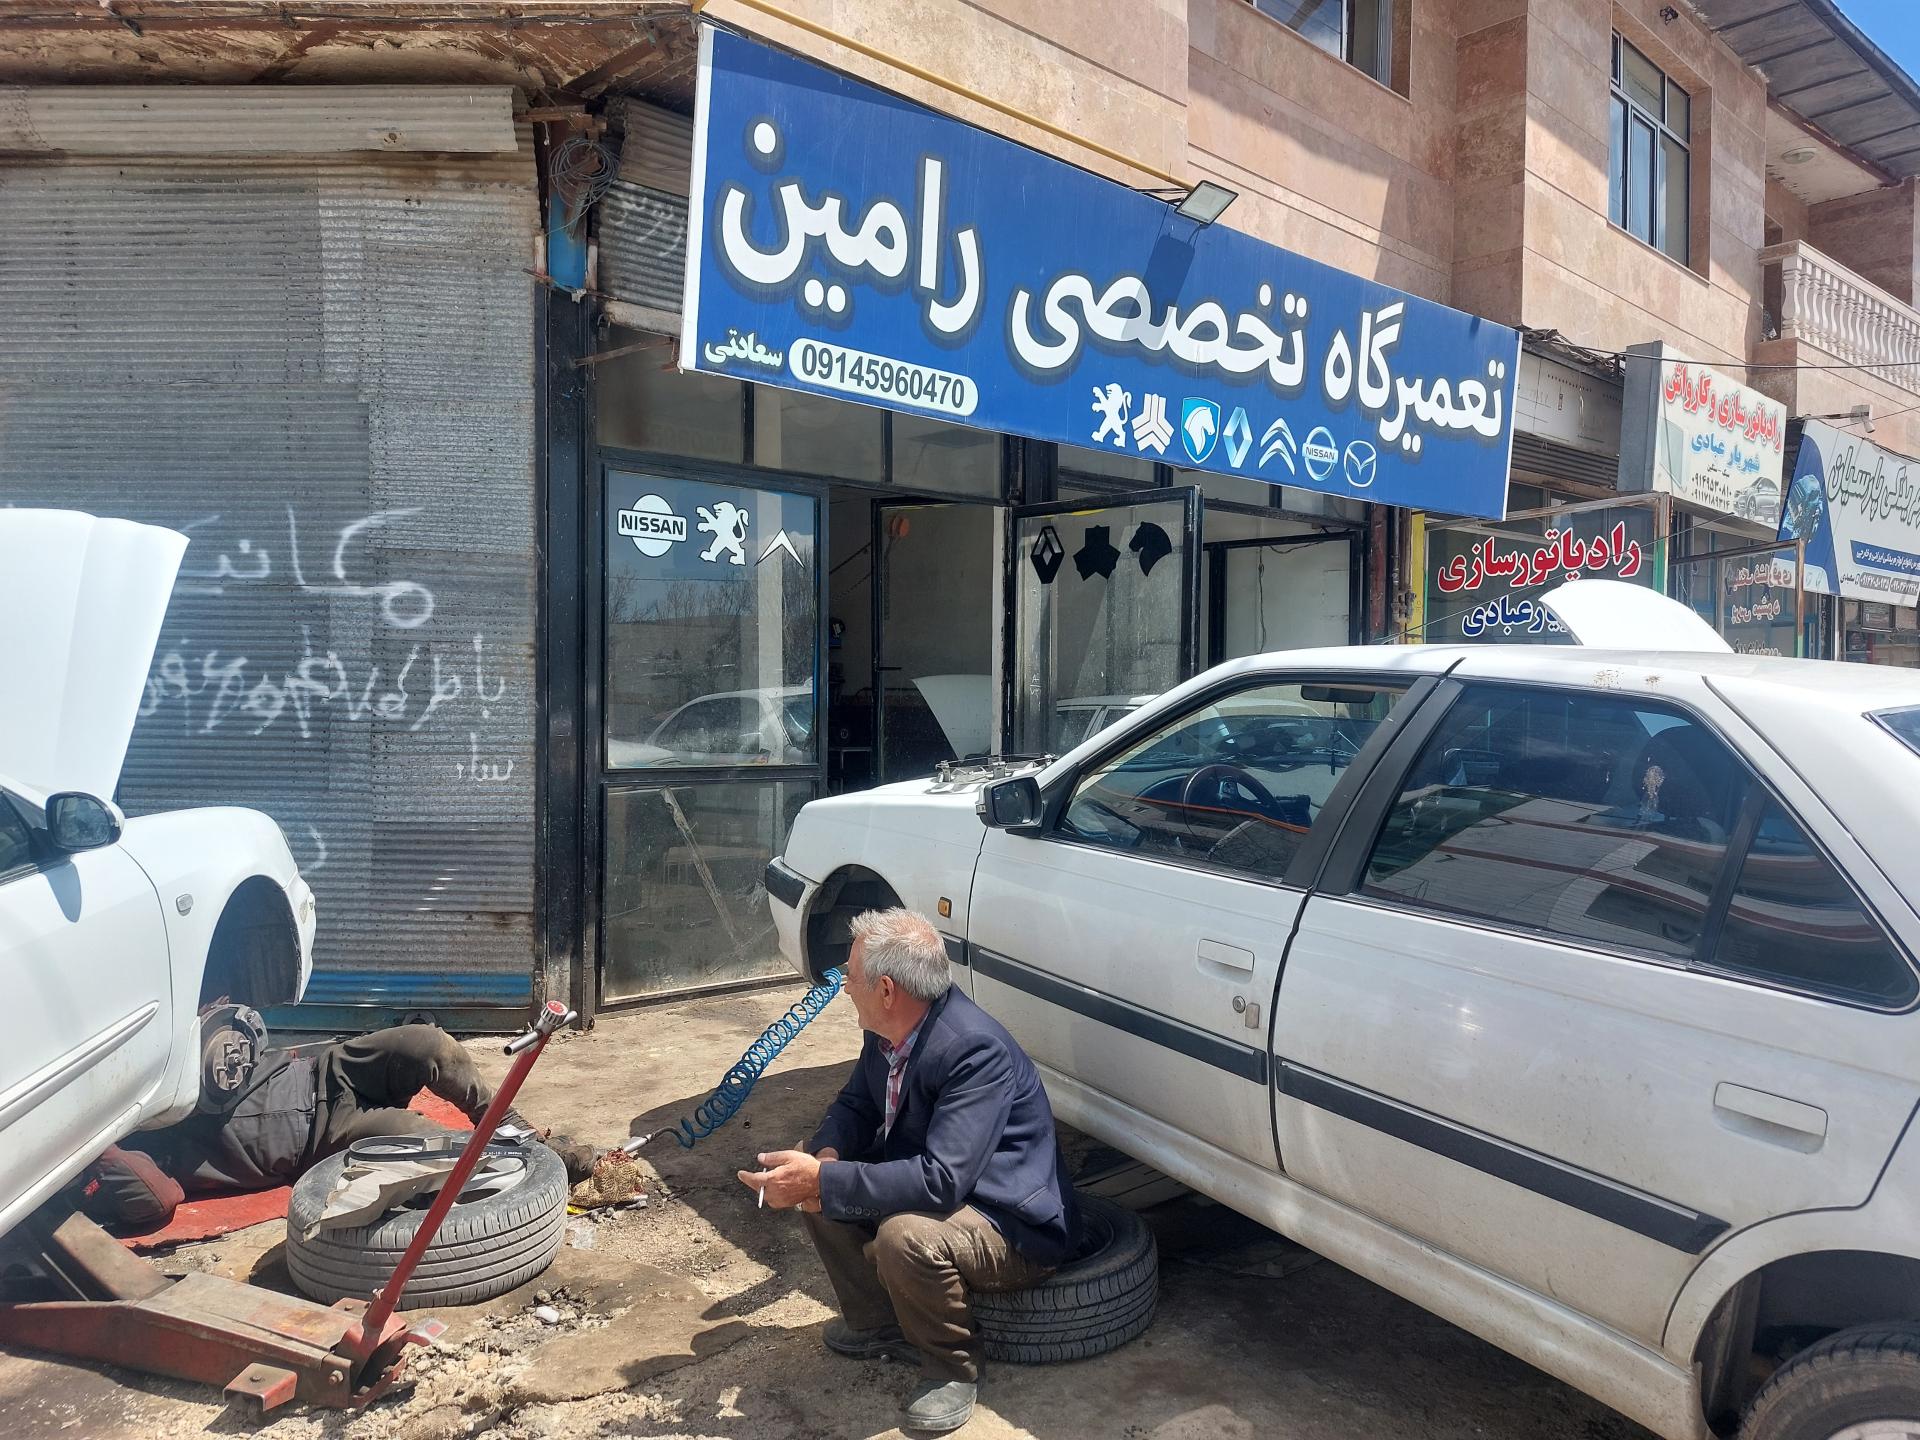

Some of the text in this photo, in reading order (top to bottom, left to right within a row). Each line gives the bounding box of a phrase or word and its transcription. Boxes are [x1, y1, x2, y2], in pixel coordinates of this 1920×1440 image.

[721, 122, 980, 333] رامین
[704, 328, 783, 367] سعادتی
[1011, 274, 1308, 387] تخصصی
[800, 343, 967, 410] 09145960470
[1324, 302, 1505, 454] تعمیرگاه
[1305, 446, 1336, 461] NISSAN
[1692, 432, 1725, 458] عبادی
[1827, 445, 1884, 521] پارسیان
[621, 514, 685, 536] NISSAN
[1461, 594, 1534, 637] عبادی
